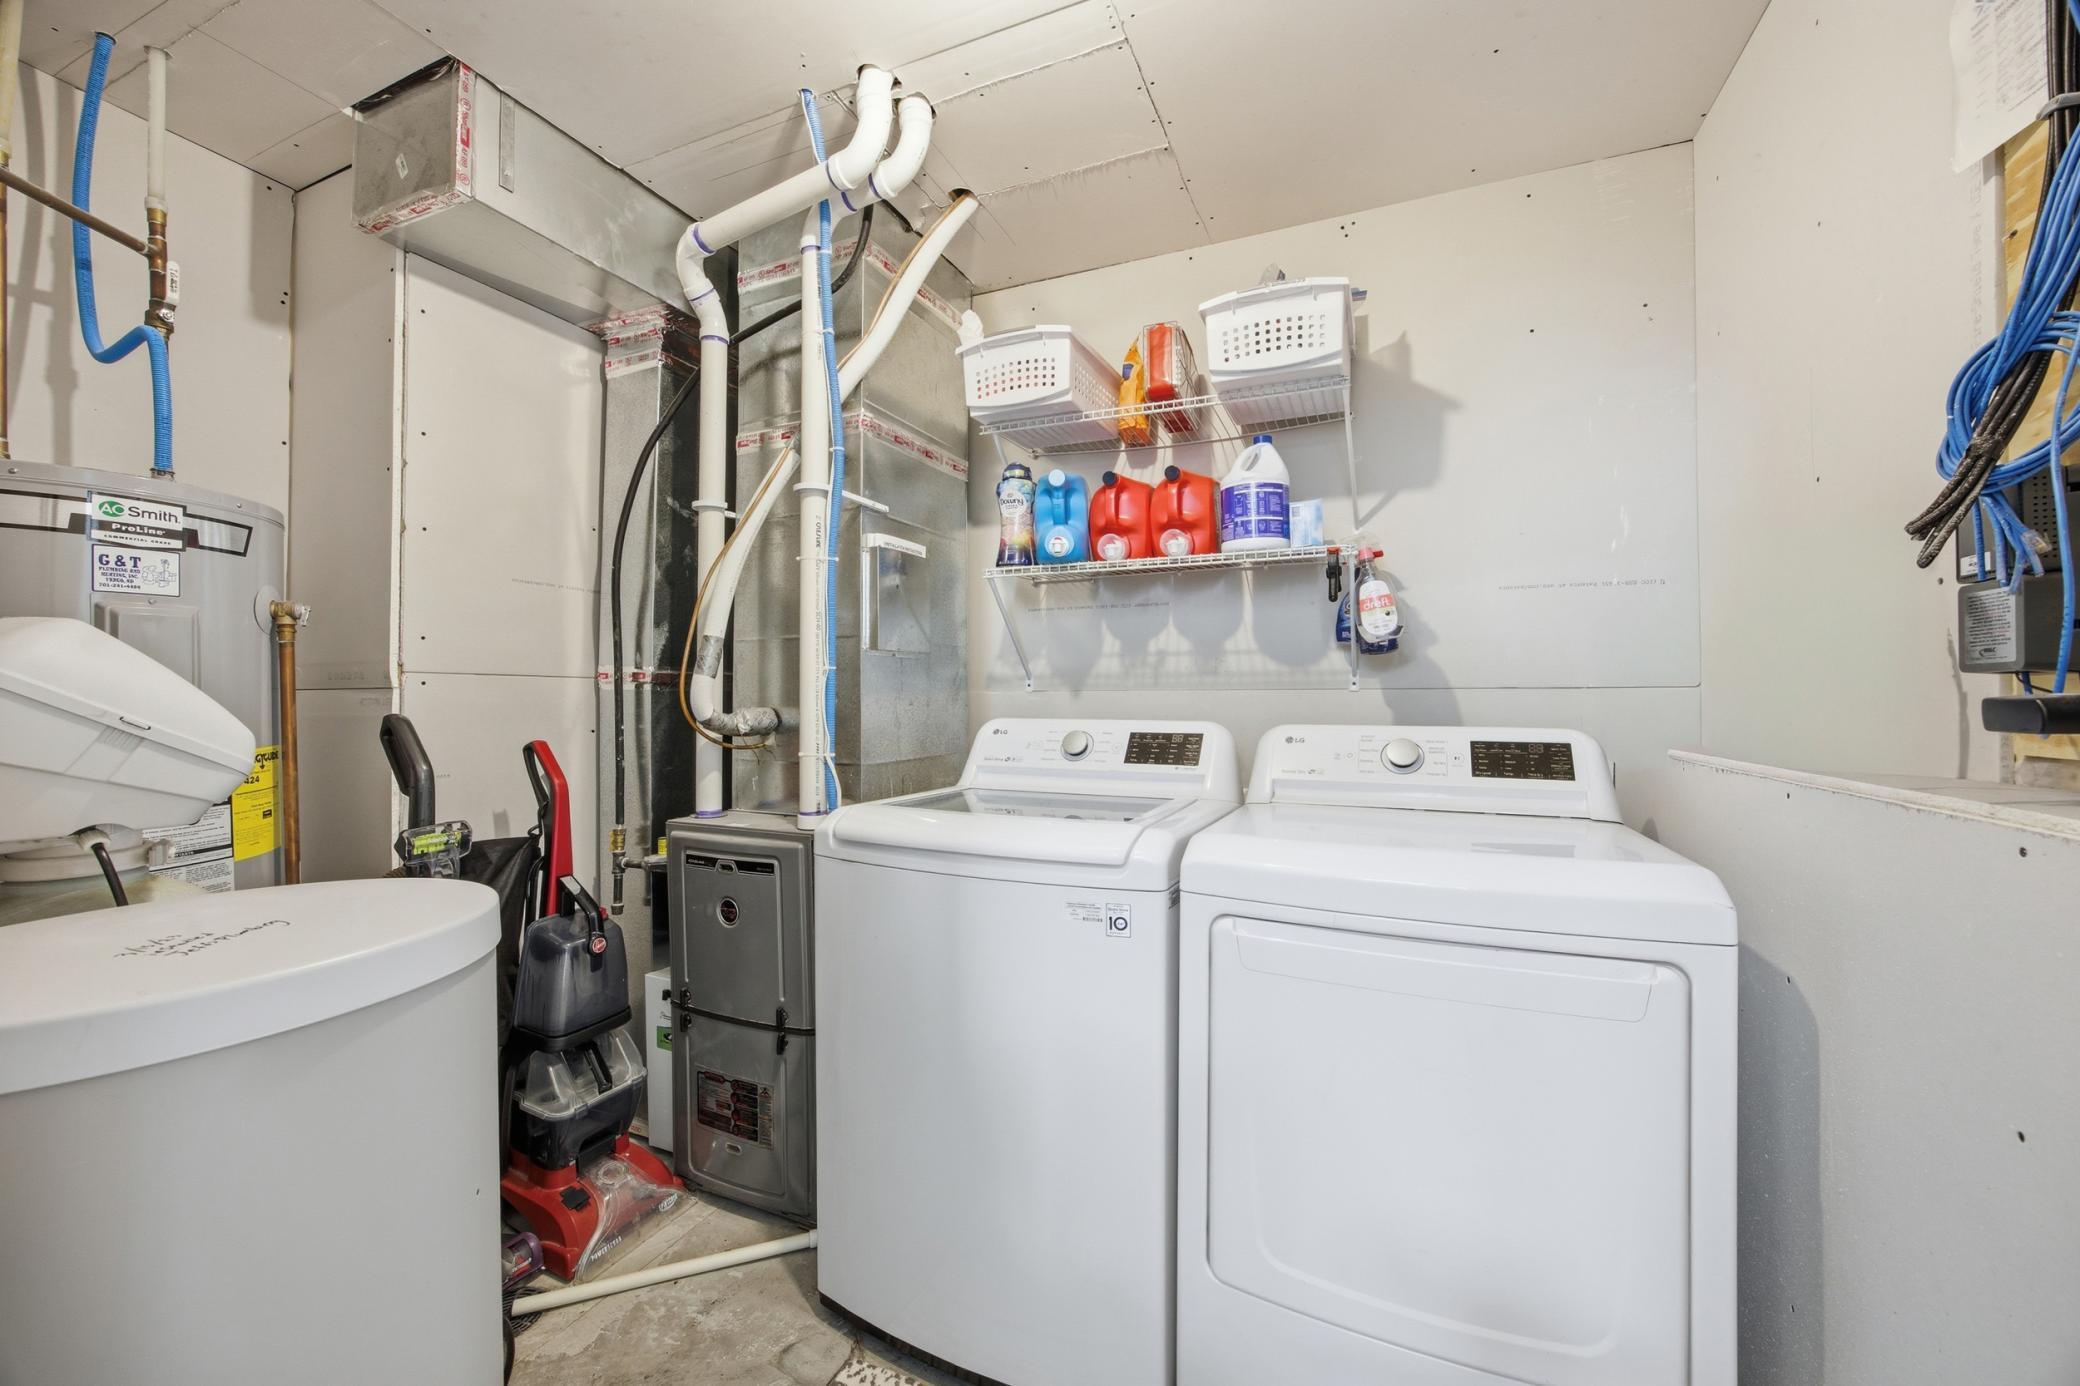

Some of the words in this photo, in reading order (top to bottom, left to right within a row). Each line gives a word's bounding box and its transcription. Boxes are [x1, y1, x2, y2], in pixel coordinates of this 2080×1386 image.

[128, 506, 179, 524] Smith
[98, 554, 110, 566] G
[114, 555, 126, 567] &
[129, 556, 142, 568] T
[1108, 916, 1128, 931] 10
